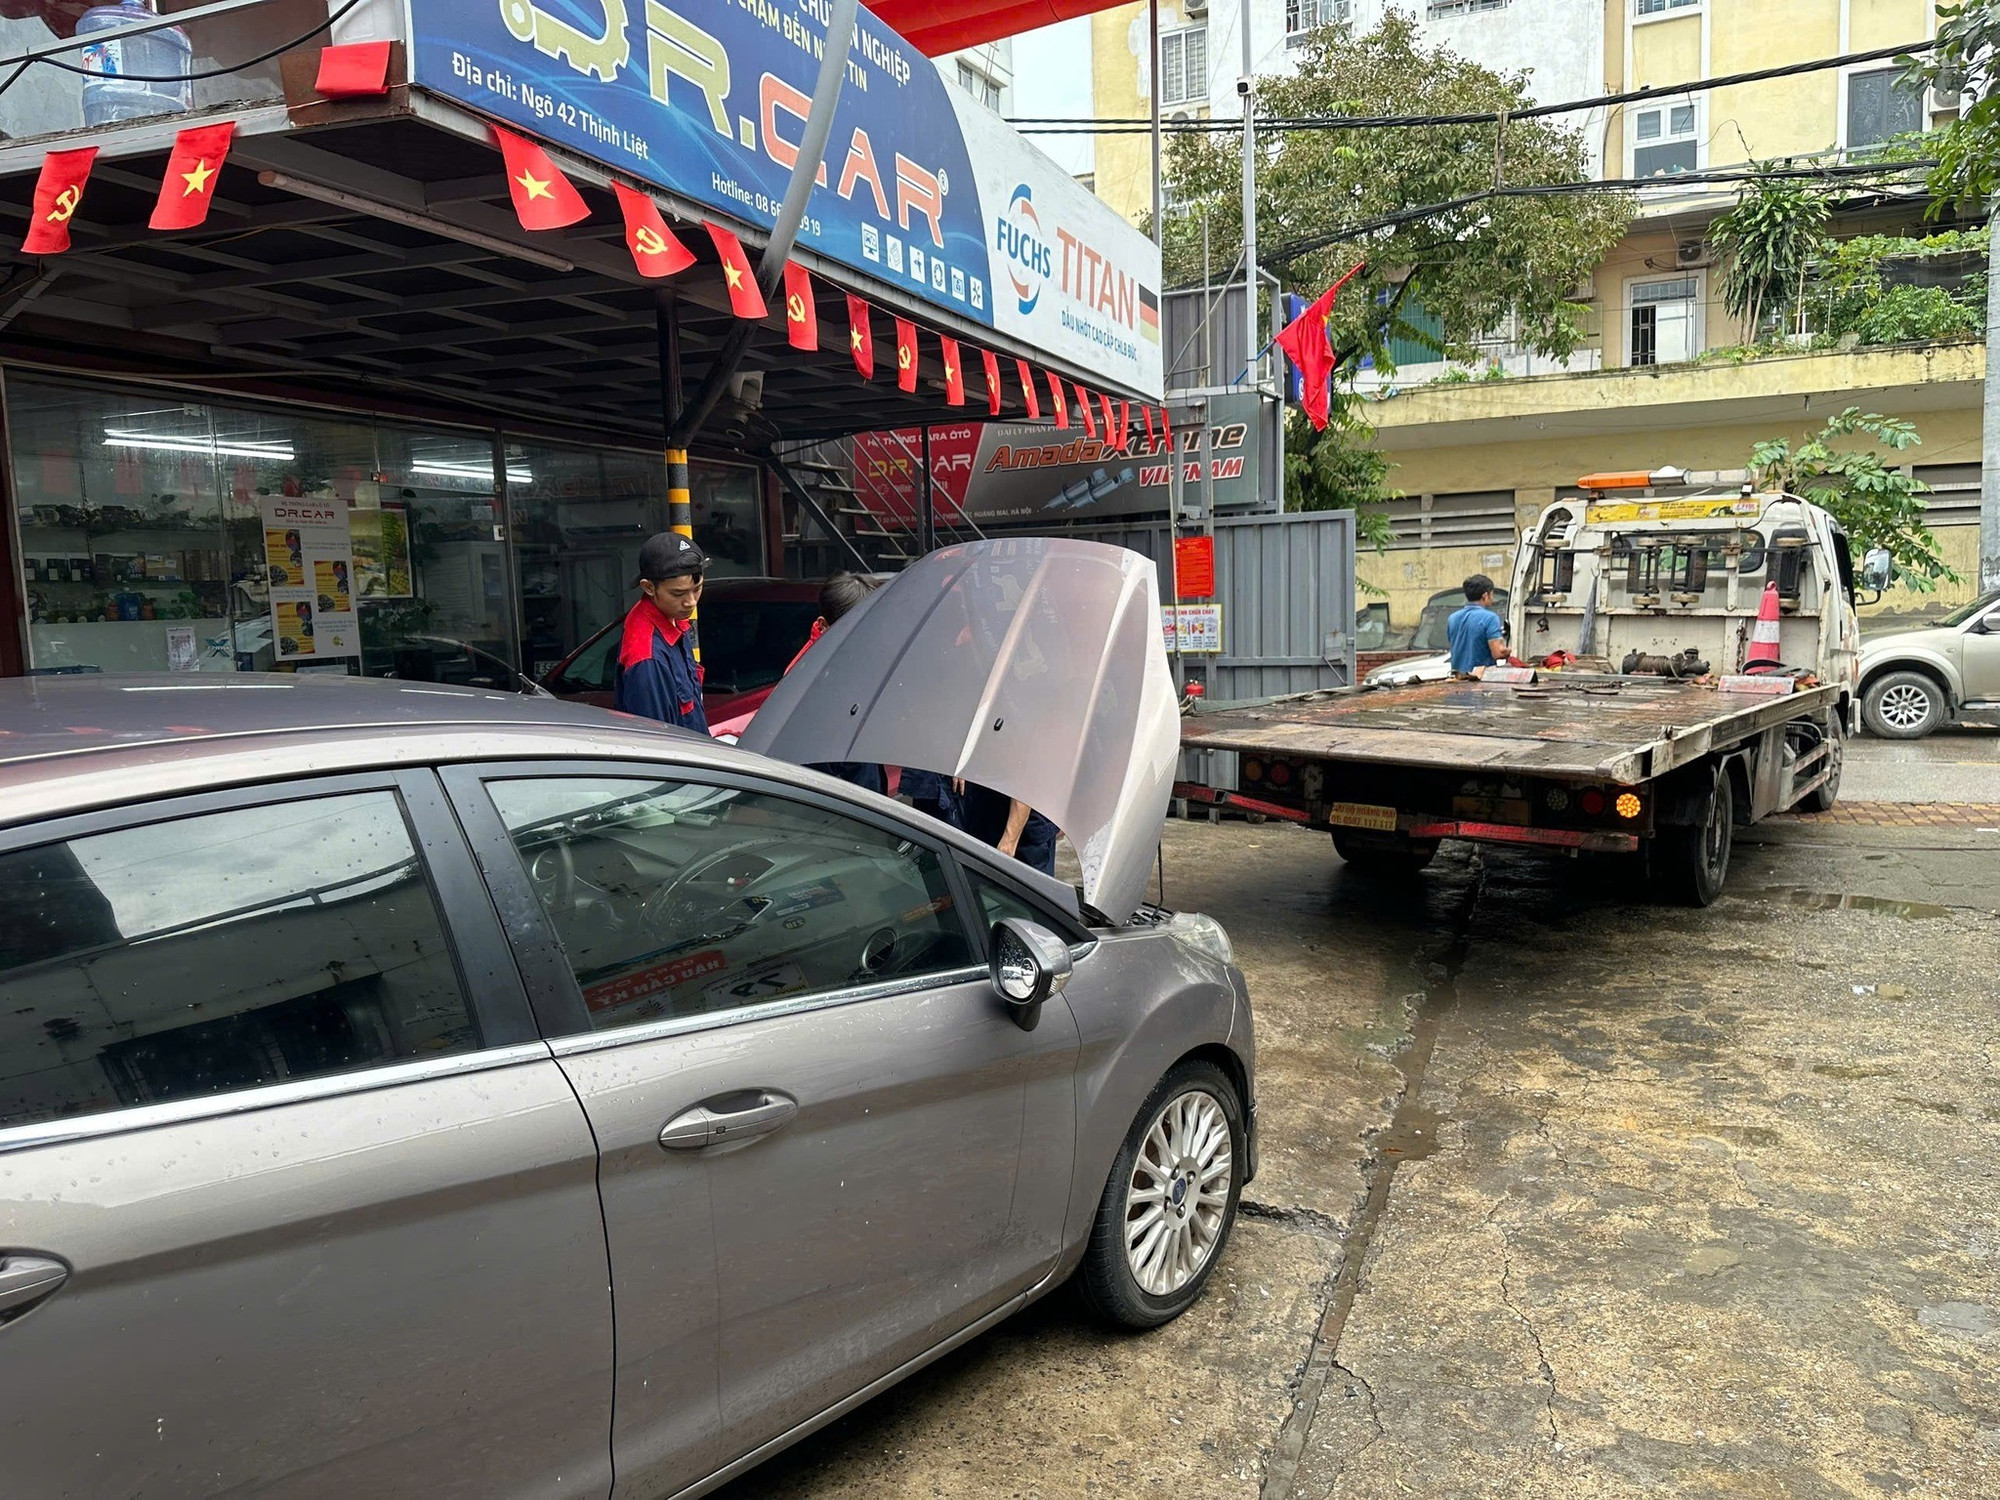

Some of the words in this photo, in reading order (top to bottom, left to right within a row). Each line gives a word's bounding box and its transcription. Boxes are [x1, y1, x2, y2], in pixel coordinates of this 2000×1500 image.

[846, 58, 868, 92] TIN
[861, 28, 911, 88] NGHIỆP
[451, 51, 482, 85] Địa
[486, 72, 518, 100] chỉ:
[521, 83, 554, 119] Ngõ
[557, 101, 577, 128] 42
[578, 109, 621, 148] Thịnh
[622, 130, 649, 160] Liệt
[711, 170, 755, 207] Hotline:
[755, 192, 769, 213] 08
[810, 218, 822, 237] 19
[996, 216, 1052, 279] FUCHS
[1056, 225, 1135, 331] TITAN
[868, 452, 973, 478] DR.AR
[274, 507, 335, 520] DR.CAR
